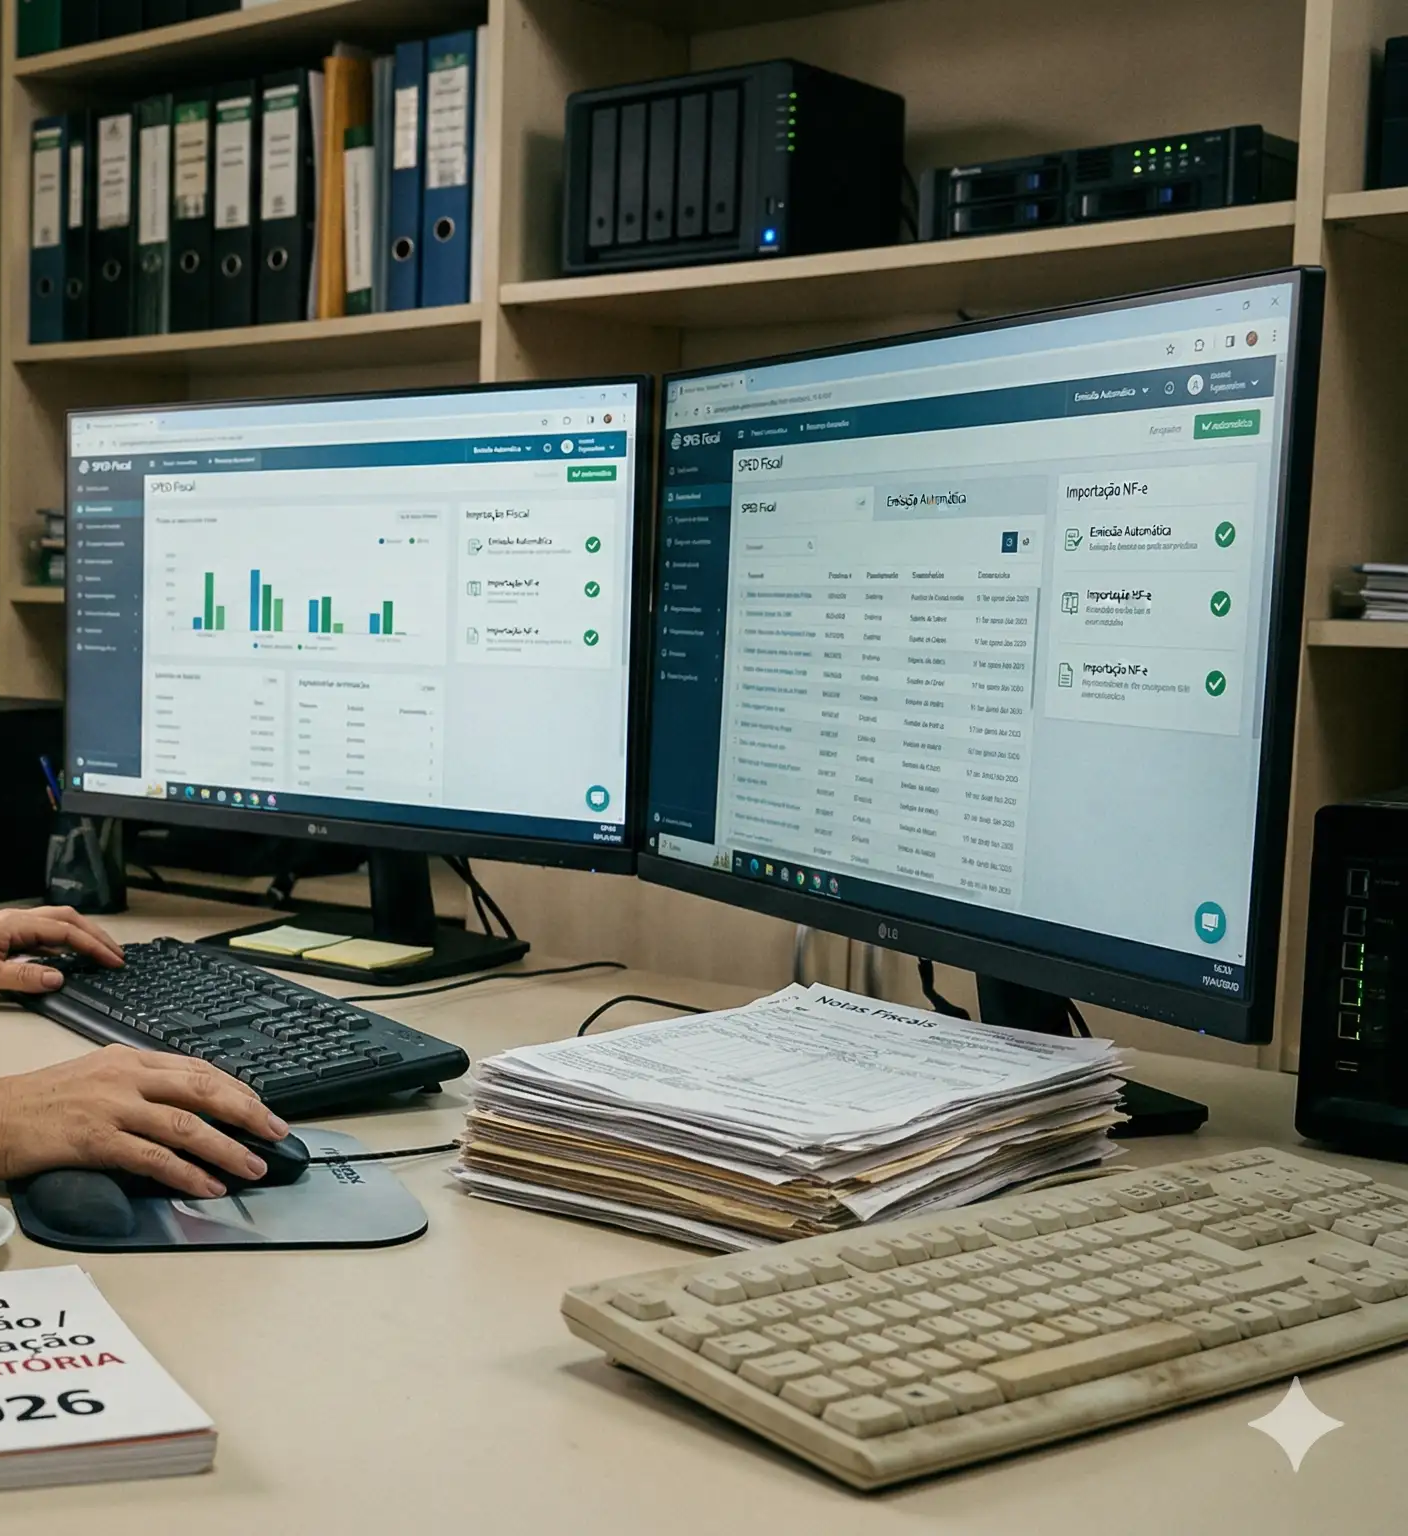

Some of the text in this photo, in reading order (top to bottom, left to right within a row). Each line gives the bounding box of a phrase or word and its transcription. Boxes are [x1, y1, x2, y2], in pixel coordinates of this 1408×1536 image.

[1123, 482, 1149, 496] NF-e
[815, 995, 870, 1014] Notas
[57, 1310, 66, 1328] /
